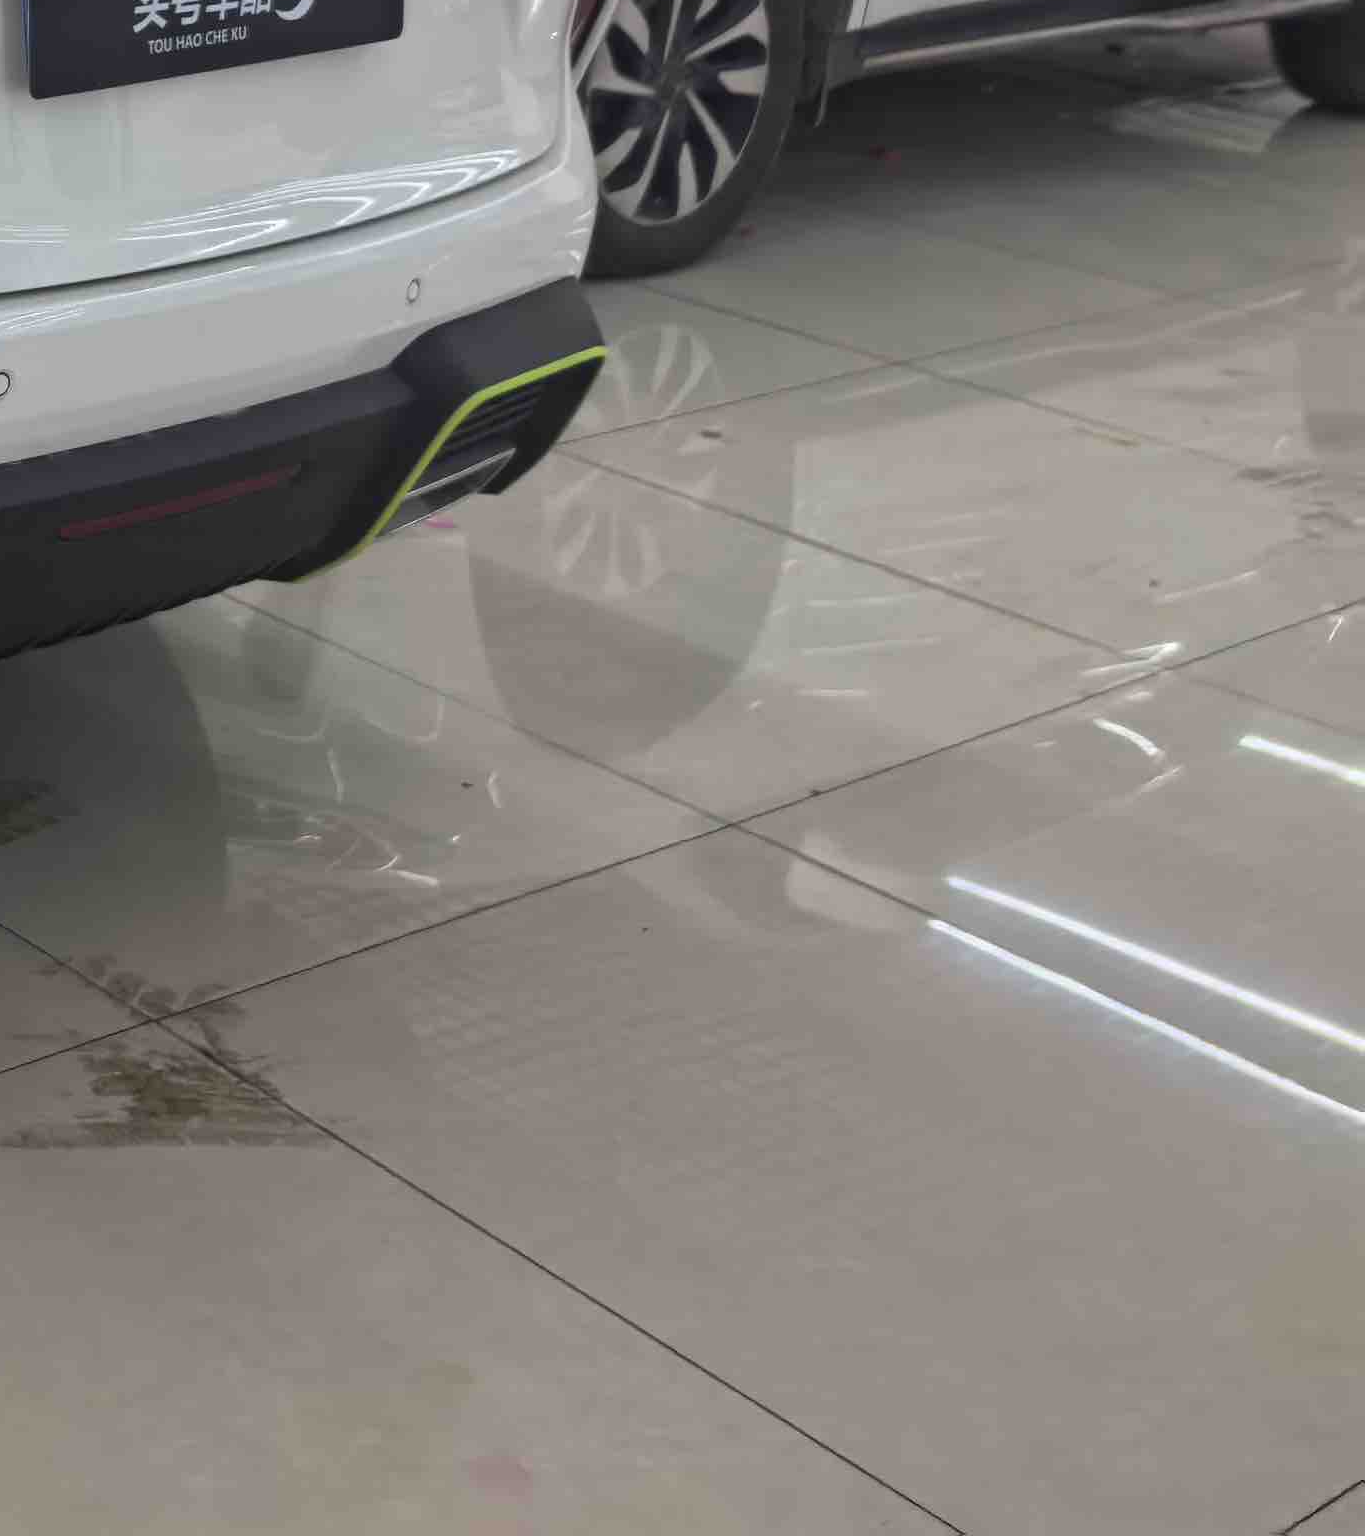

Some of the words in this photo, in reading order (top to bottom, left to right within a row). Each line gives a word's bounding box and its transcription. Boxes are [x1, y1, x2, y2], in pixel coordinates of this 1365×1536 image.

[148, 37, 173, 55] TOU
[176, 32, 202, 50] HAO
[205, 26, 229, 46] CHE
[230, 25, 248, 41] KU
